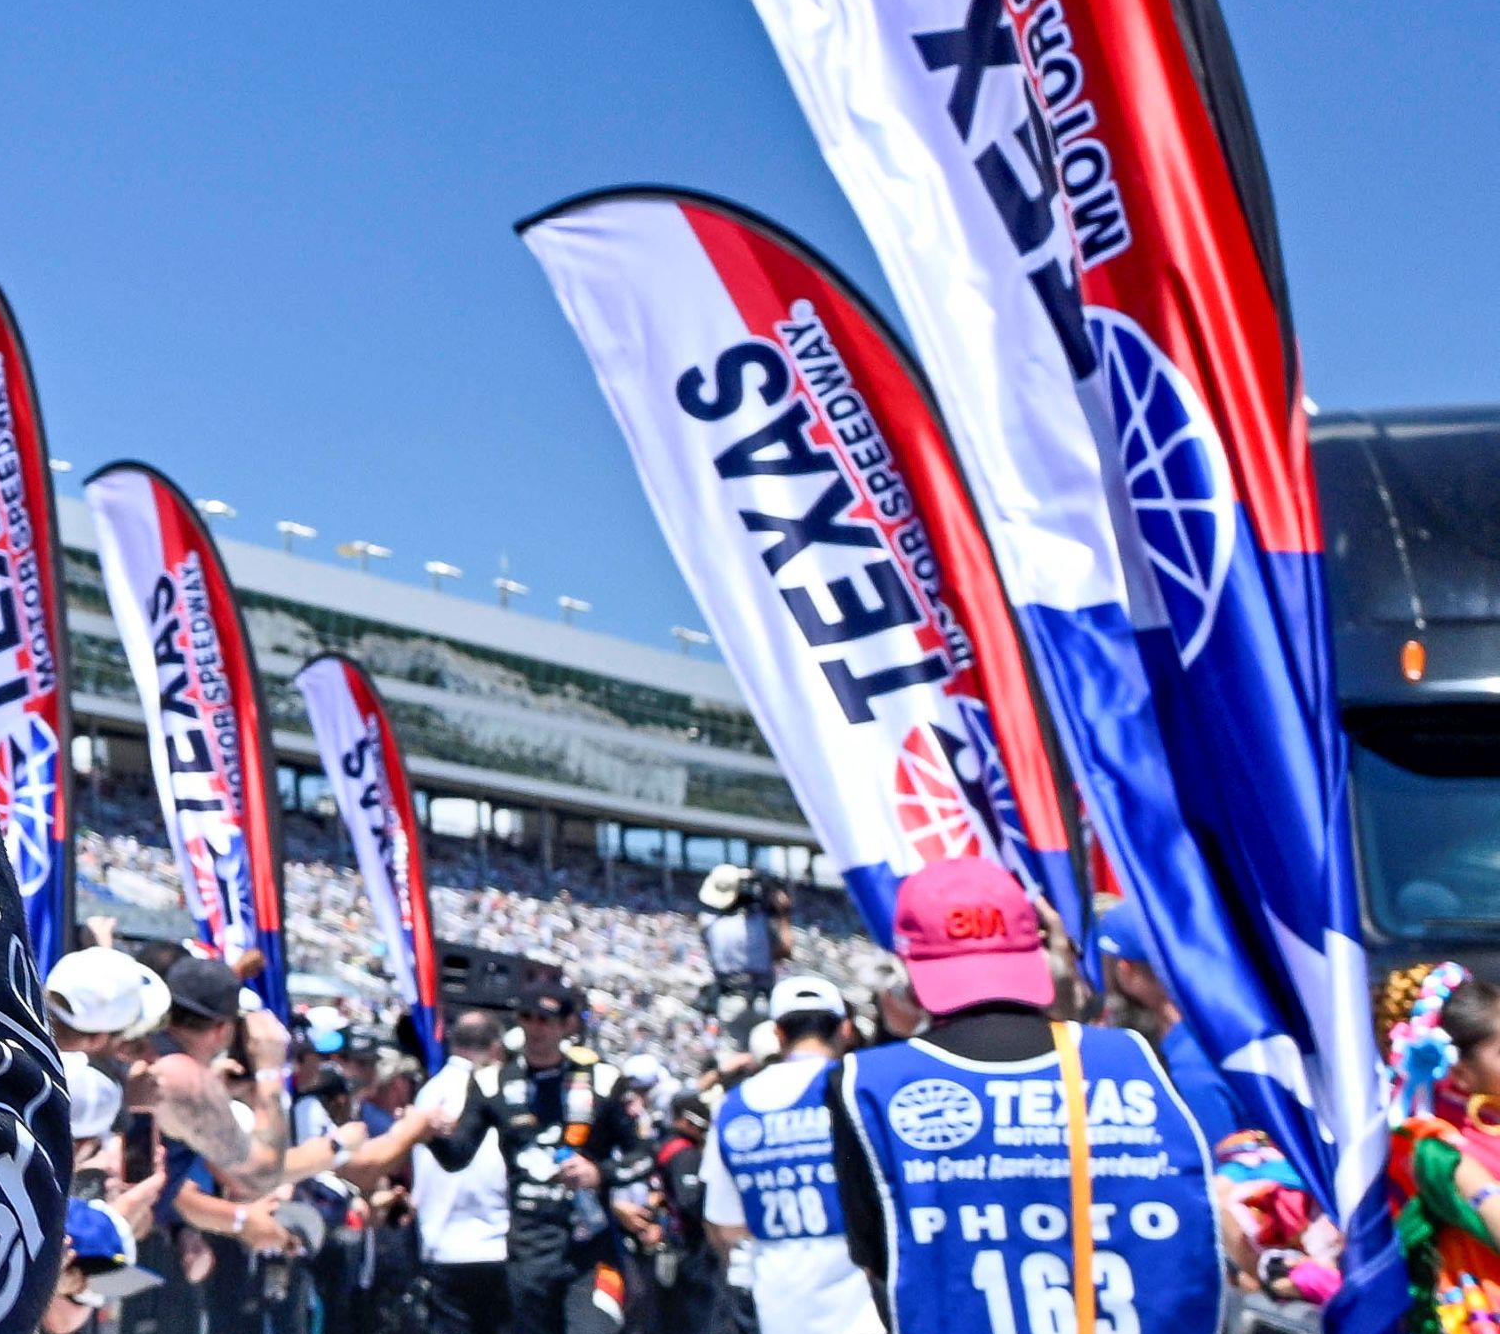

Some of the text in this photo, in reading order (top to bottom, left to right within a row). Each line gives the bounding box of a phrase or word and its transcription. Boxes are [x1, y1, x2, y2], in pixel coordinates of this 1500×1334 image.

[782, 322, 909, 517] SPEEDWAY
[676, 341, 949, 725] TEXAS
[18, 558, 56, 692] MOTOR
[909, 1200, 1180, 1245] PHOTO
